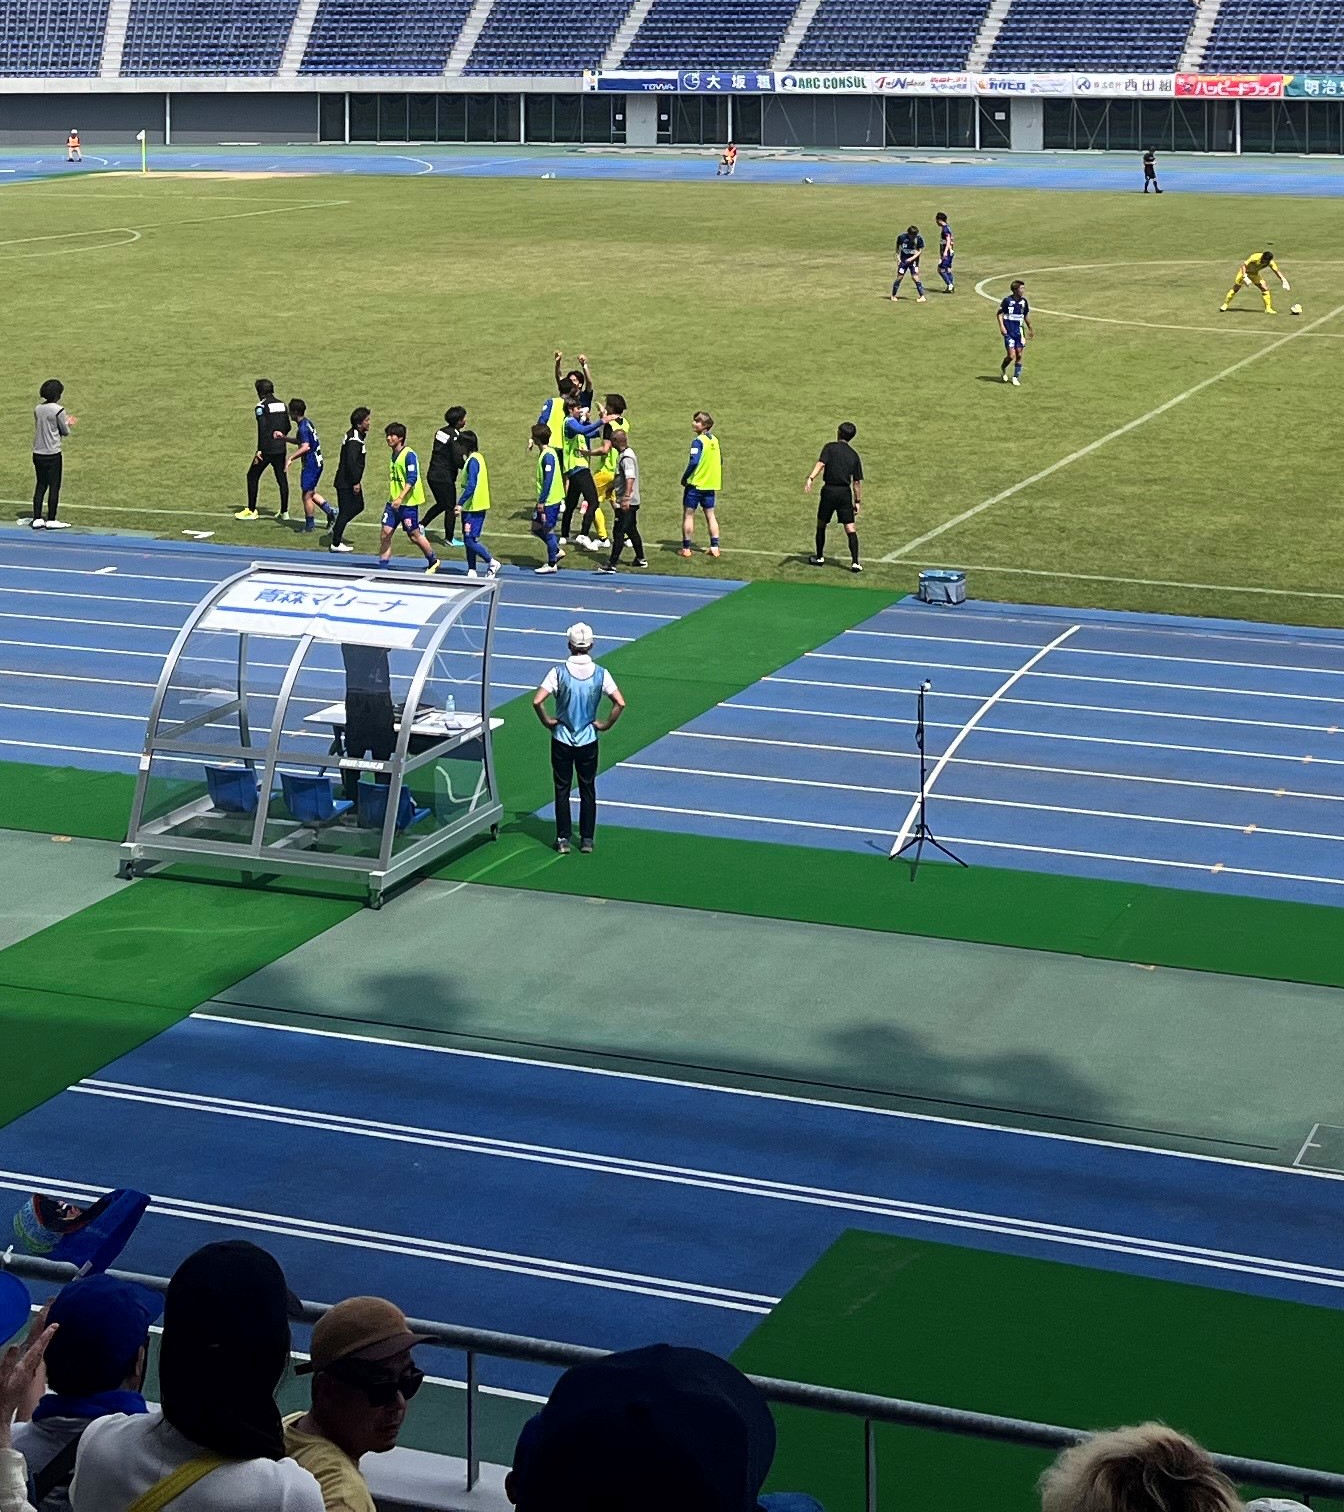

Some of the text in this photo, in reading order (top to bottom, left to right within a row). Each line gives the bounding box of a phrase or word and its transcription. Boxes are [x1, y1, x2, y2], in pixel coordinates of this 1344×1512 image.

[798, 76, 867, 89] ARC CONSUL
[1194, 80, 1280, 95] ハッピードラッグ
[254, 588, 408, 612] 青森マリーナ
